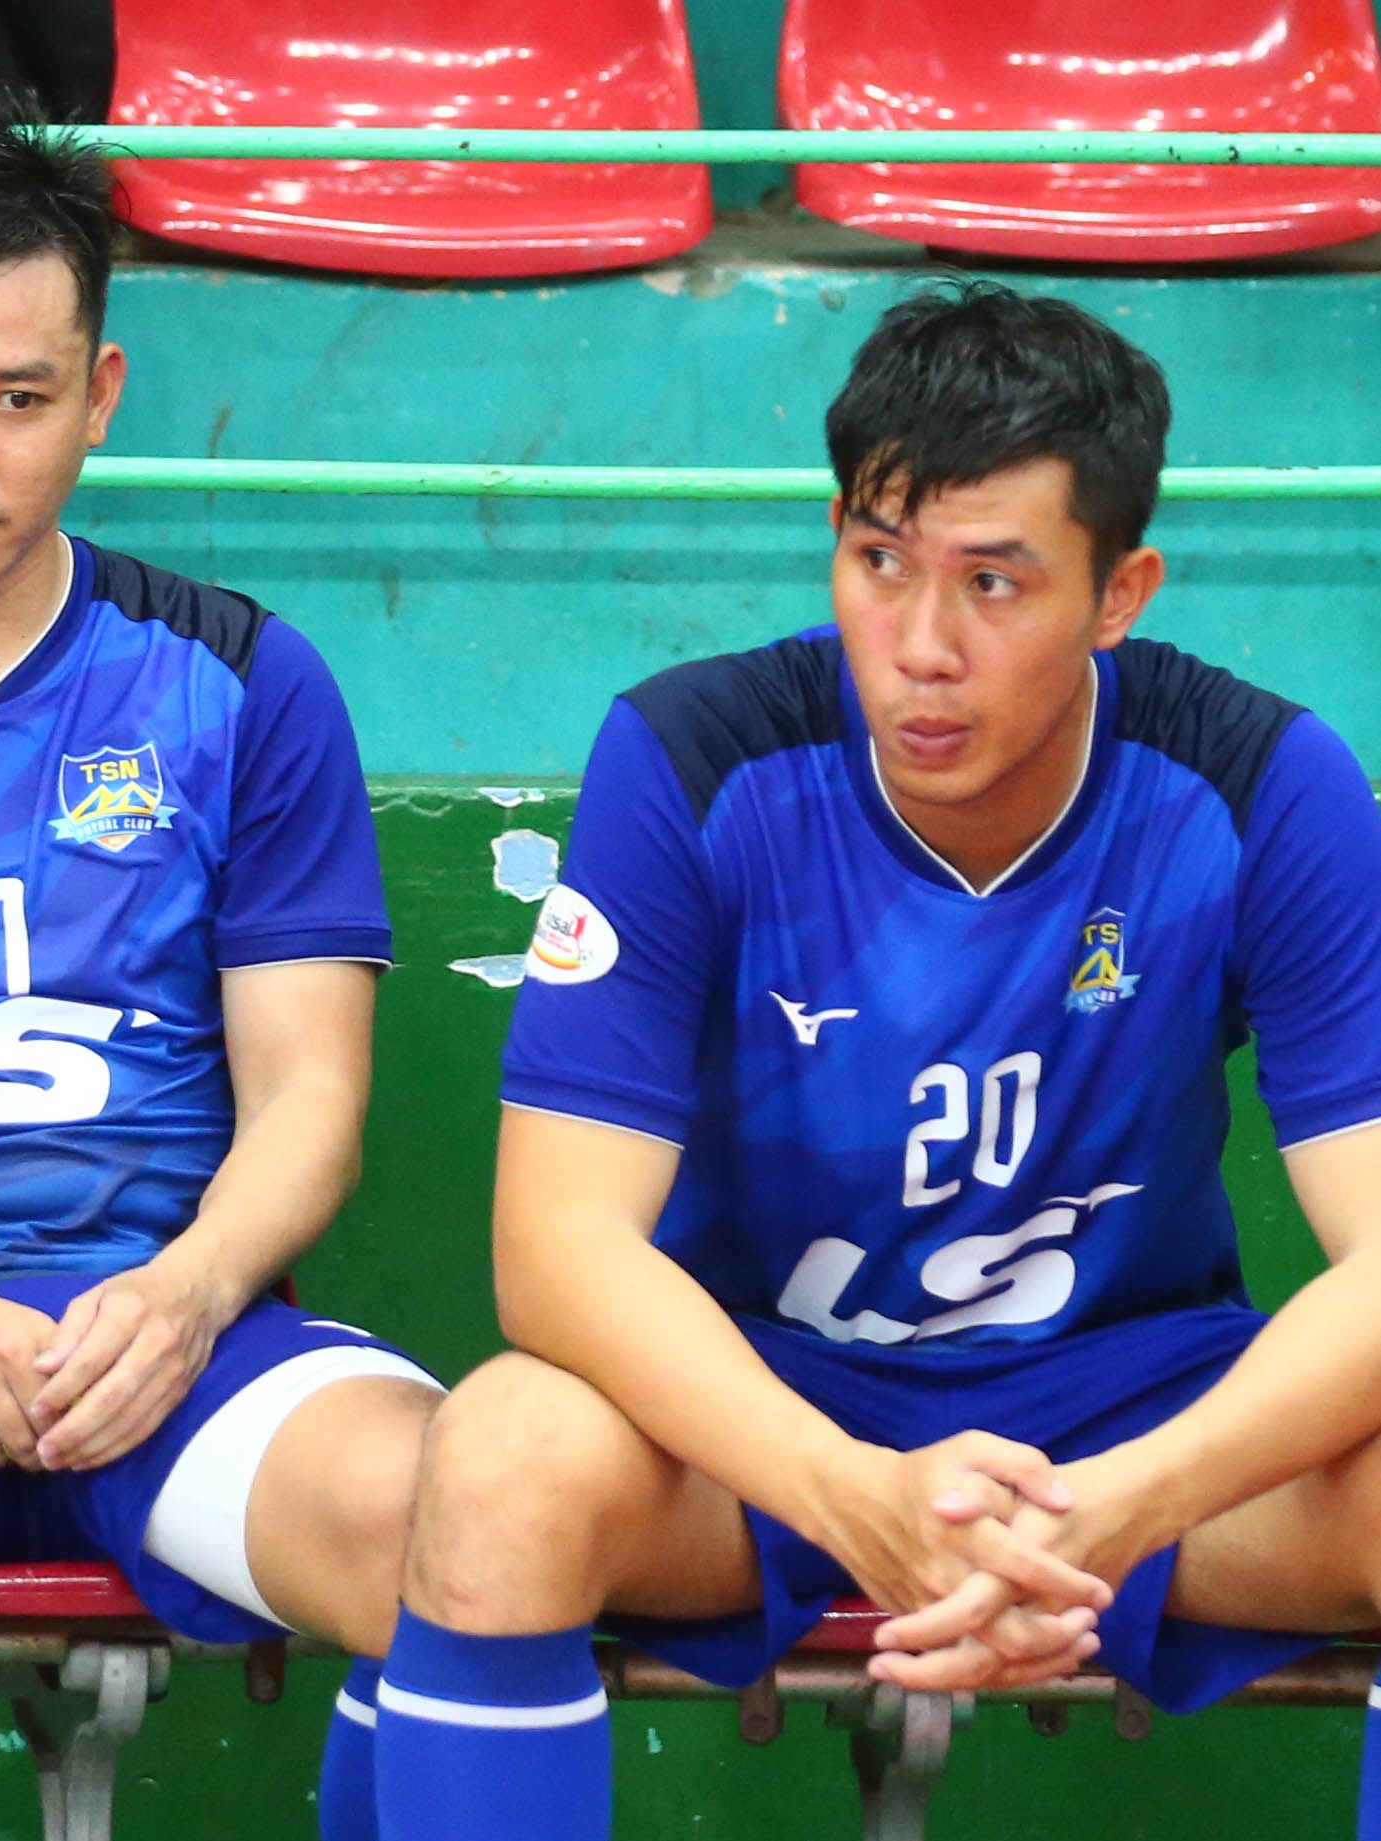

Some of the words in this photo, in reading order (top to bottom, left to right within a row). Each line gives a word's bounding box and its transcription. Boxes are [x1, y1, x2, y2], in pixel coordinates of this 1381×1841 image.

[80, 758, 140, 783] TSN
[124, 818, 153, 831] CLUB
[903, 1050, 1043, 1208] 20
[776, 1206, 1079, 1345] LS
